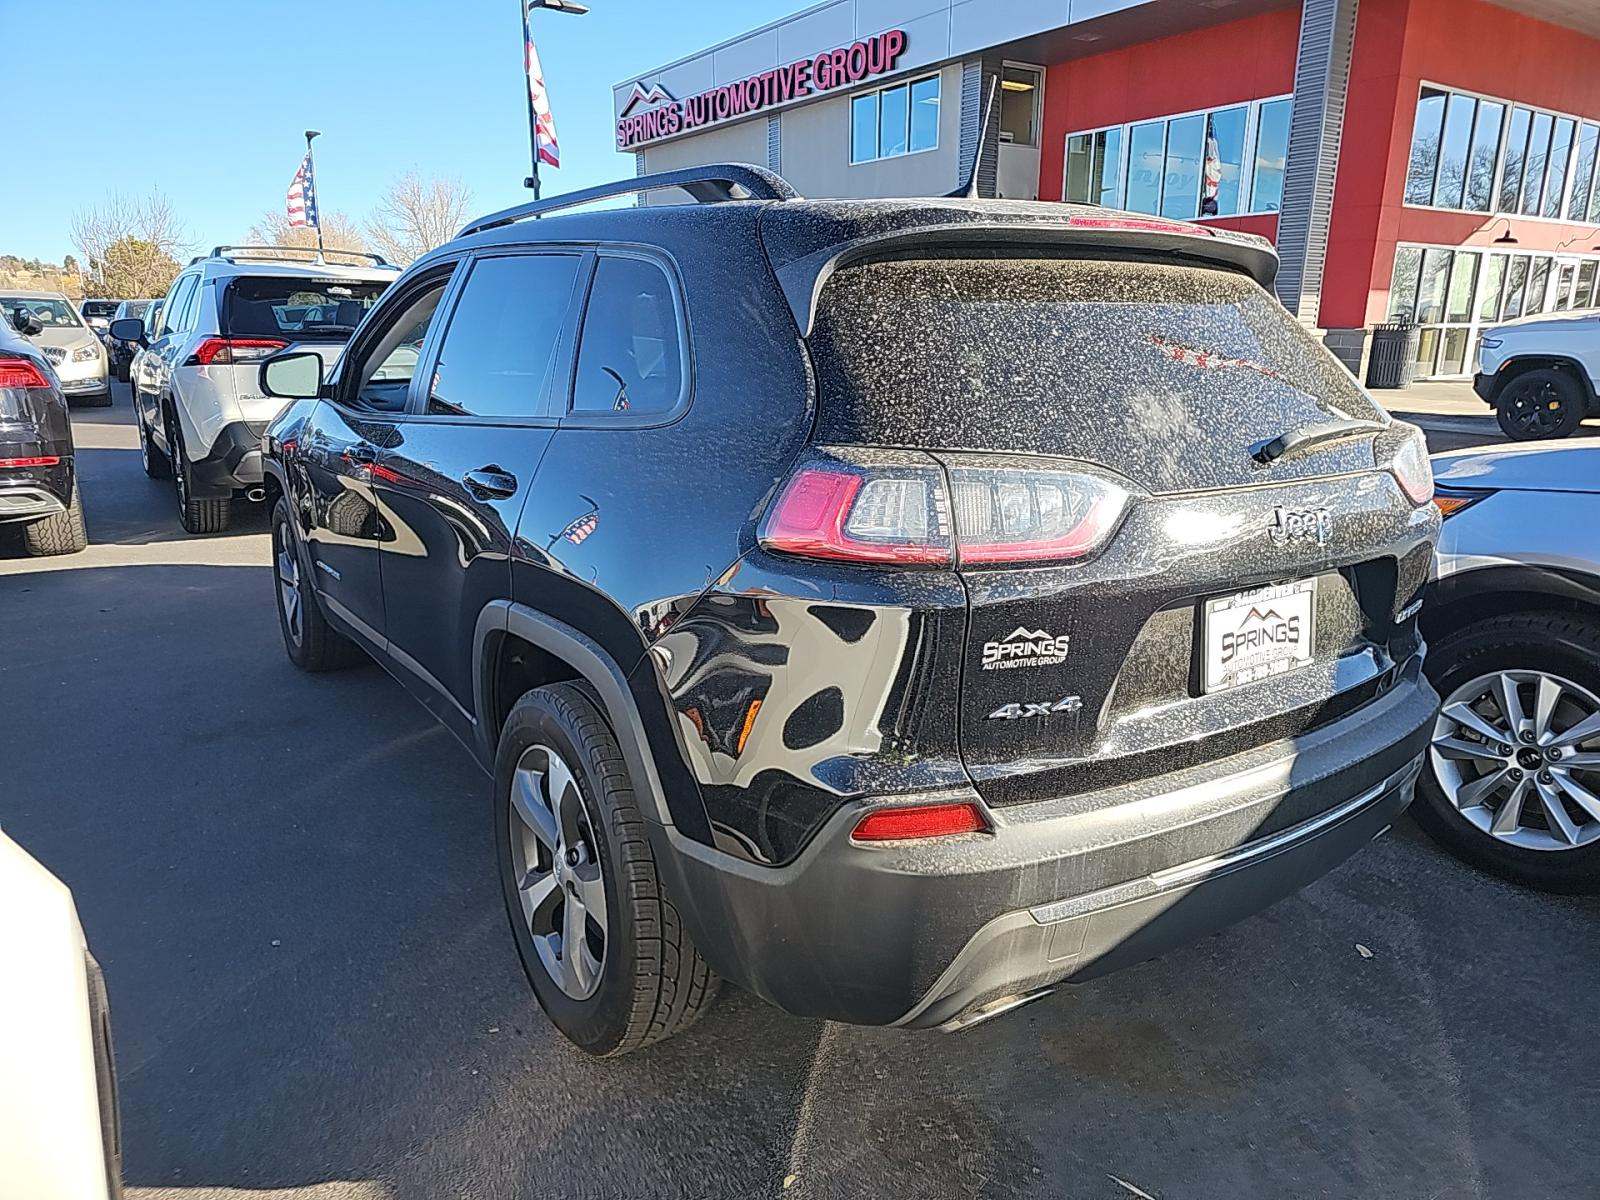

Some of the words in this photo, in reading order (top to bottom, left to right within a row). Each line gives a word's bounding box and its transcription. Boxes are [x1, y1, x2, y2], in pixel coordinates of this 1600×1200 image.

[617, 102, 681, 147] SPRINGS
[684, 59, 811, 128] AUTOMOTIVE
[813, 30, 906, 90] GROUP
[1266, 505, 1332, 547] Jeep
[982, 635, 1070, 664] SPRINGS
[1221, 615, 1300, 664] SPRINGS
[982, 656, 1037, 670] AUTOMOTIVE
[1037, 655, 1067, 666] GROUP
